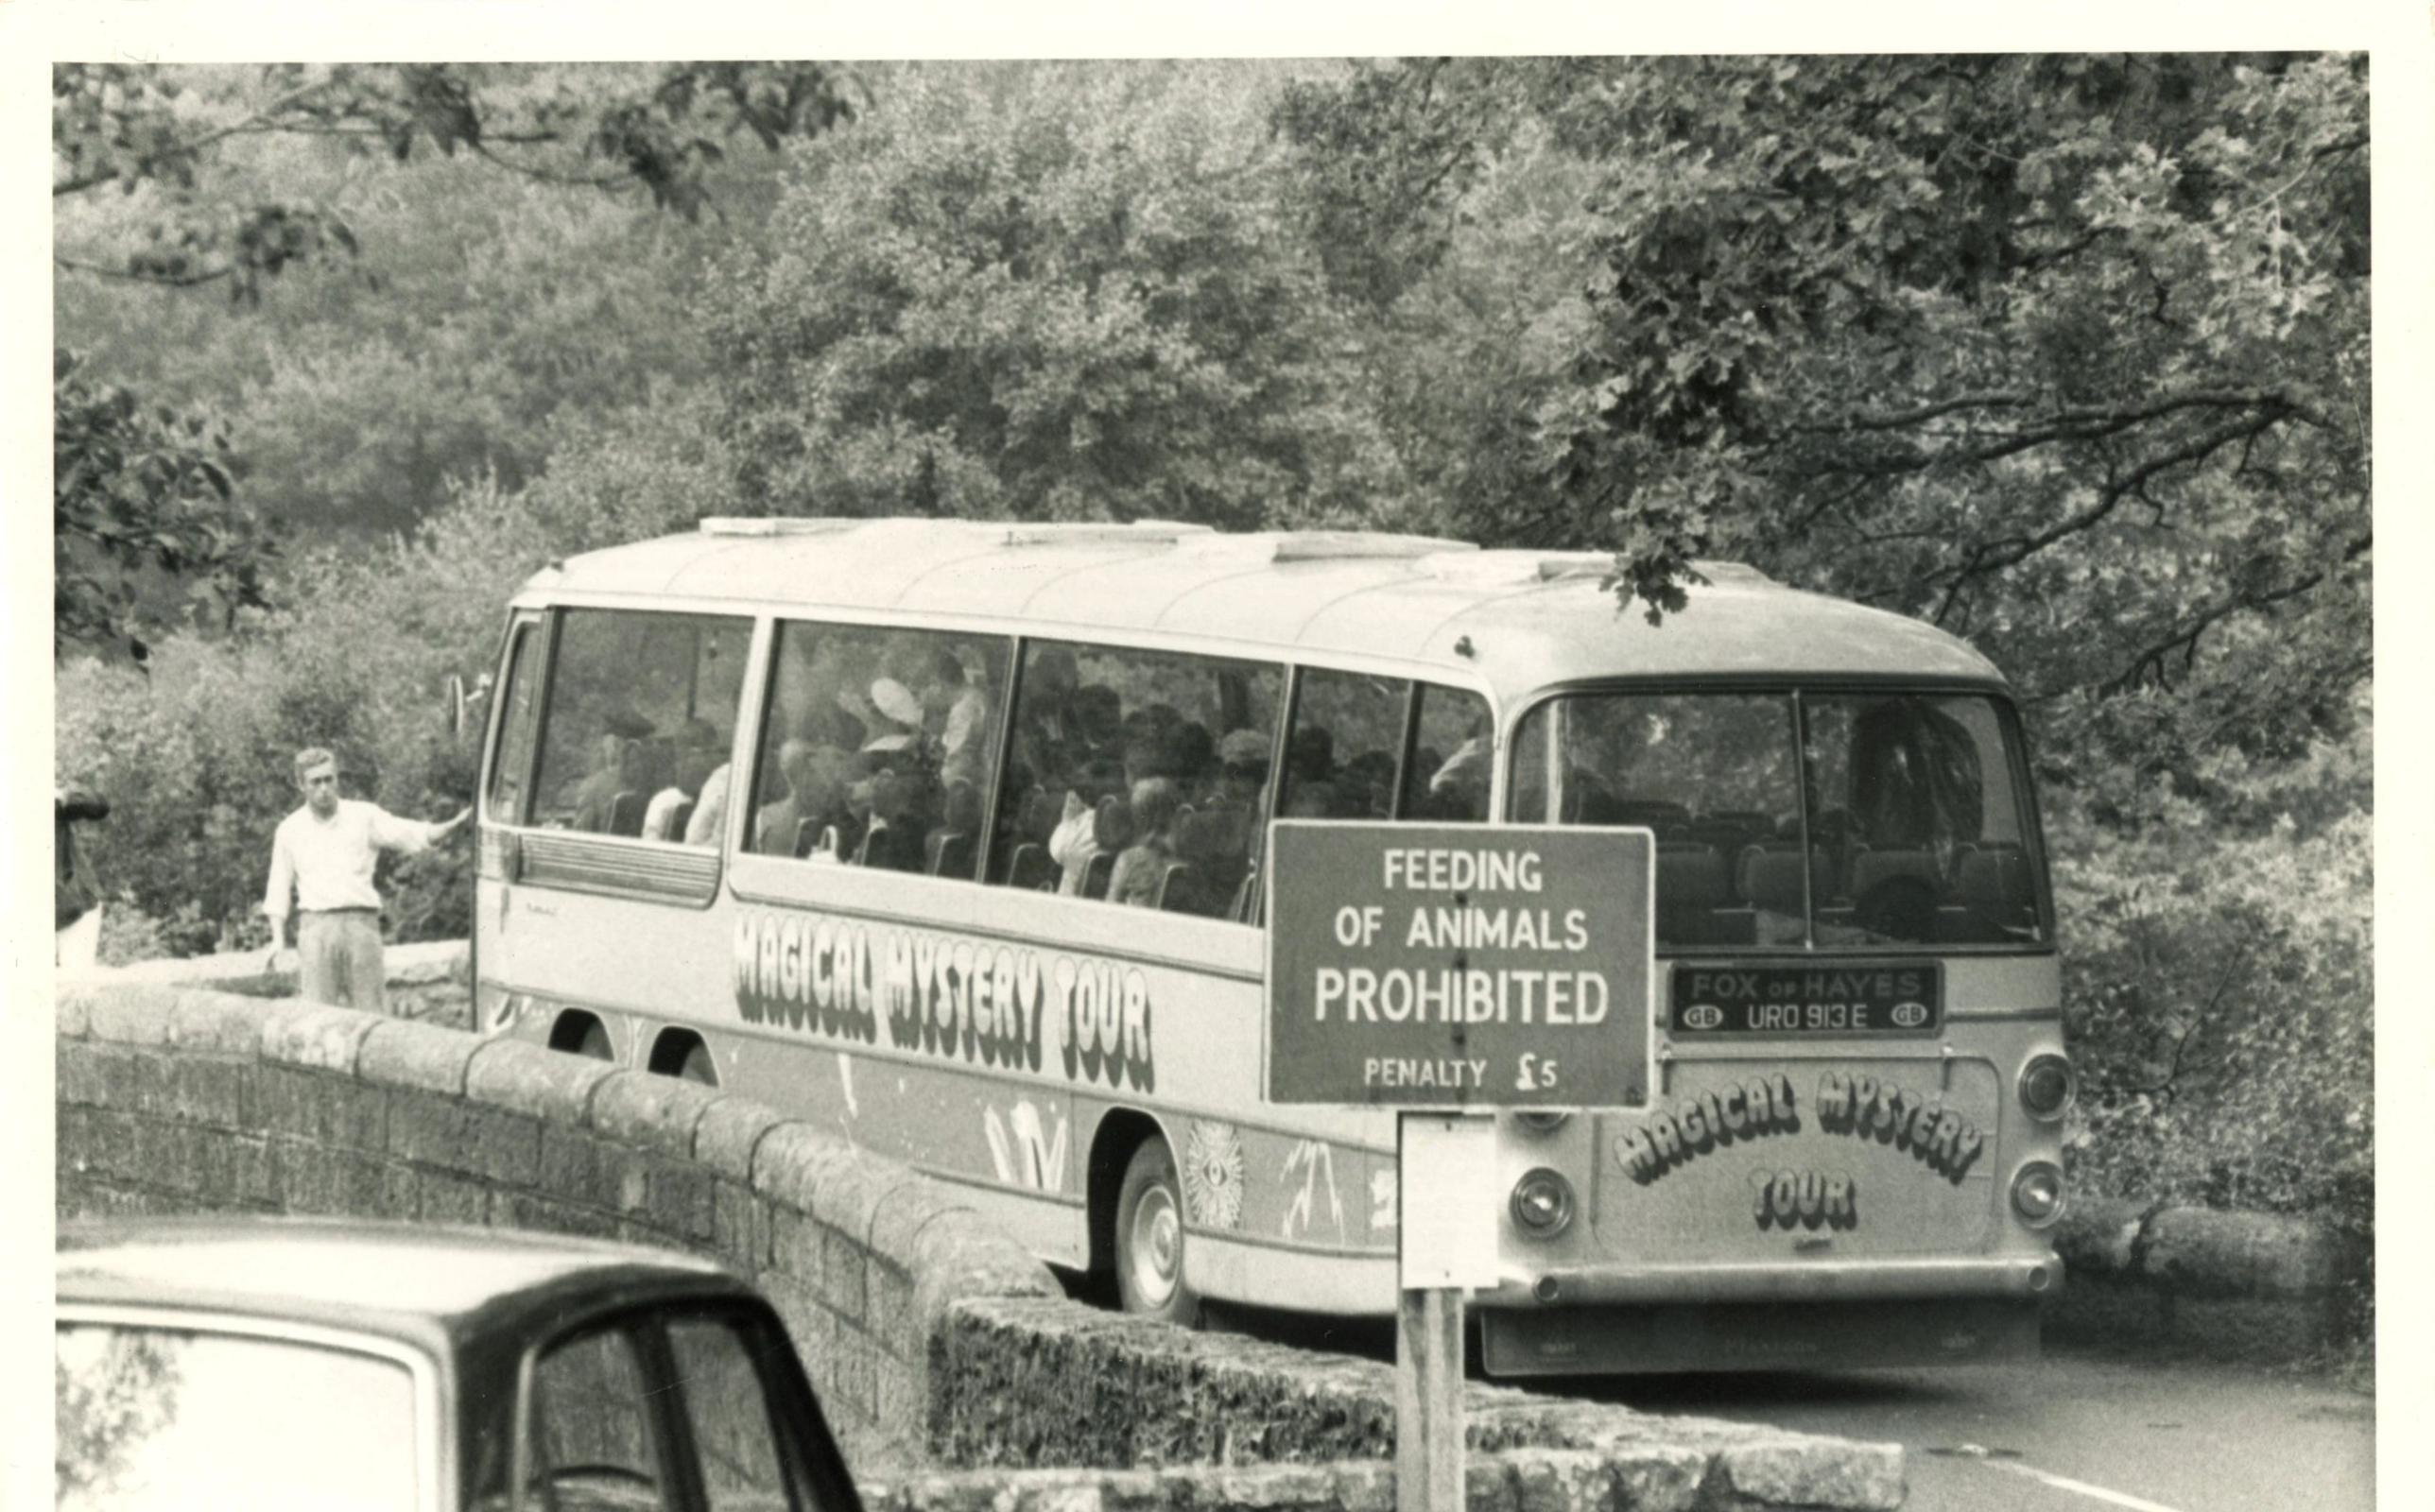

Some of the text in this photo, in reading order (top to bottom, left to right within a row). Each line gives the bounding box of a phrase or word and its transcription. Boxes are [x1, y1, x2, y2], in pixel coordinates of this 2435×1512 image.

[1384, 849, 1543, 892] FEEDING
[1335, 905, 1589, 952] OF ANIMALS
[734, 913, 1155, 1094] MAGICAL MYSTERY TOUR
[1315, 967, 1609, 1024] PROHIBITED
[1692, 973, 1759, 999] FOX
[1805, 972, 1922, 999] HAYES
[1685, 1005, 1720, 1027] GB
[1749, 1004, 1799, 1029] URO
[1893, 1004, 1926, 1025] GB
[1364, 1052, 1558, 1091] PENALTY £5
[1615, 1071, 1983, 1187] MAGICAL MYSTERY
[1747, 1168, 1858, 1230] TOUR
